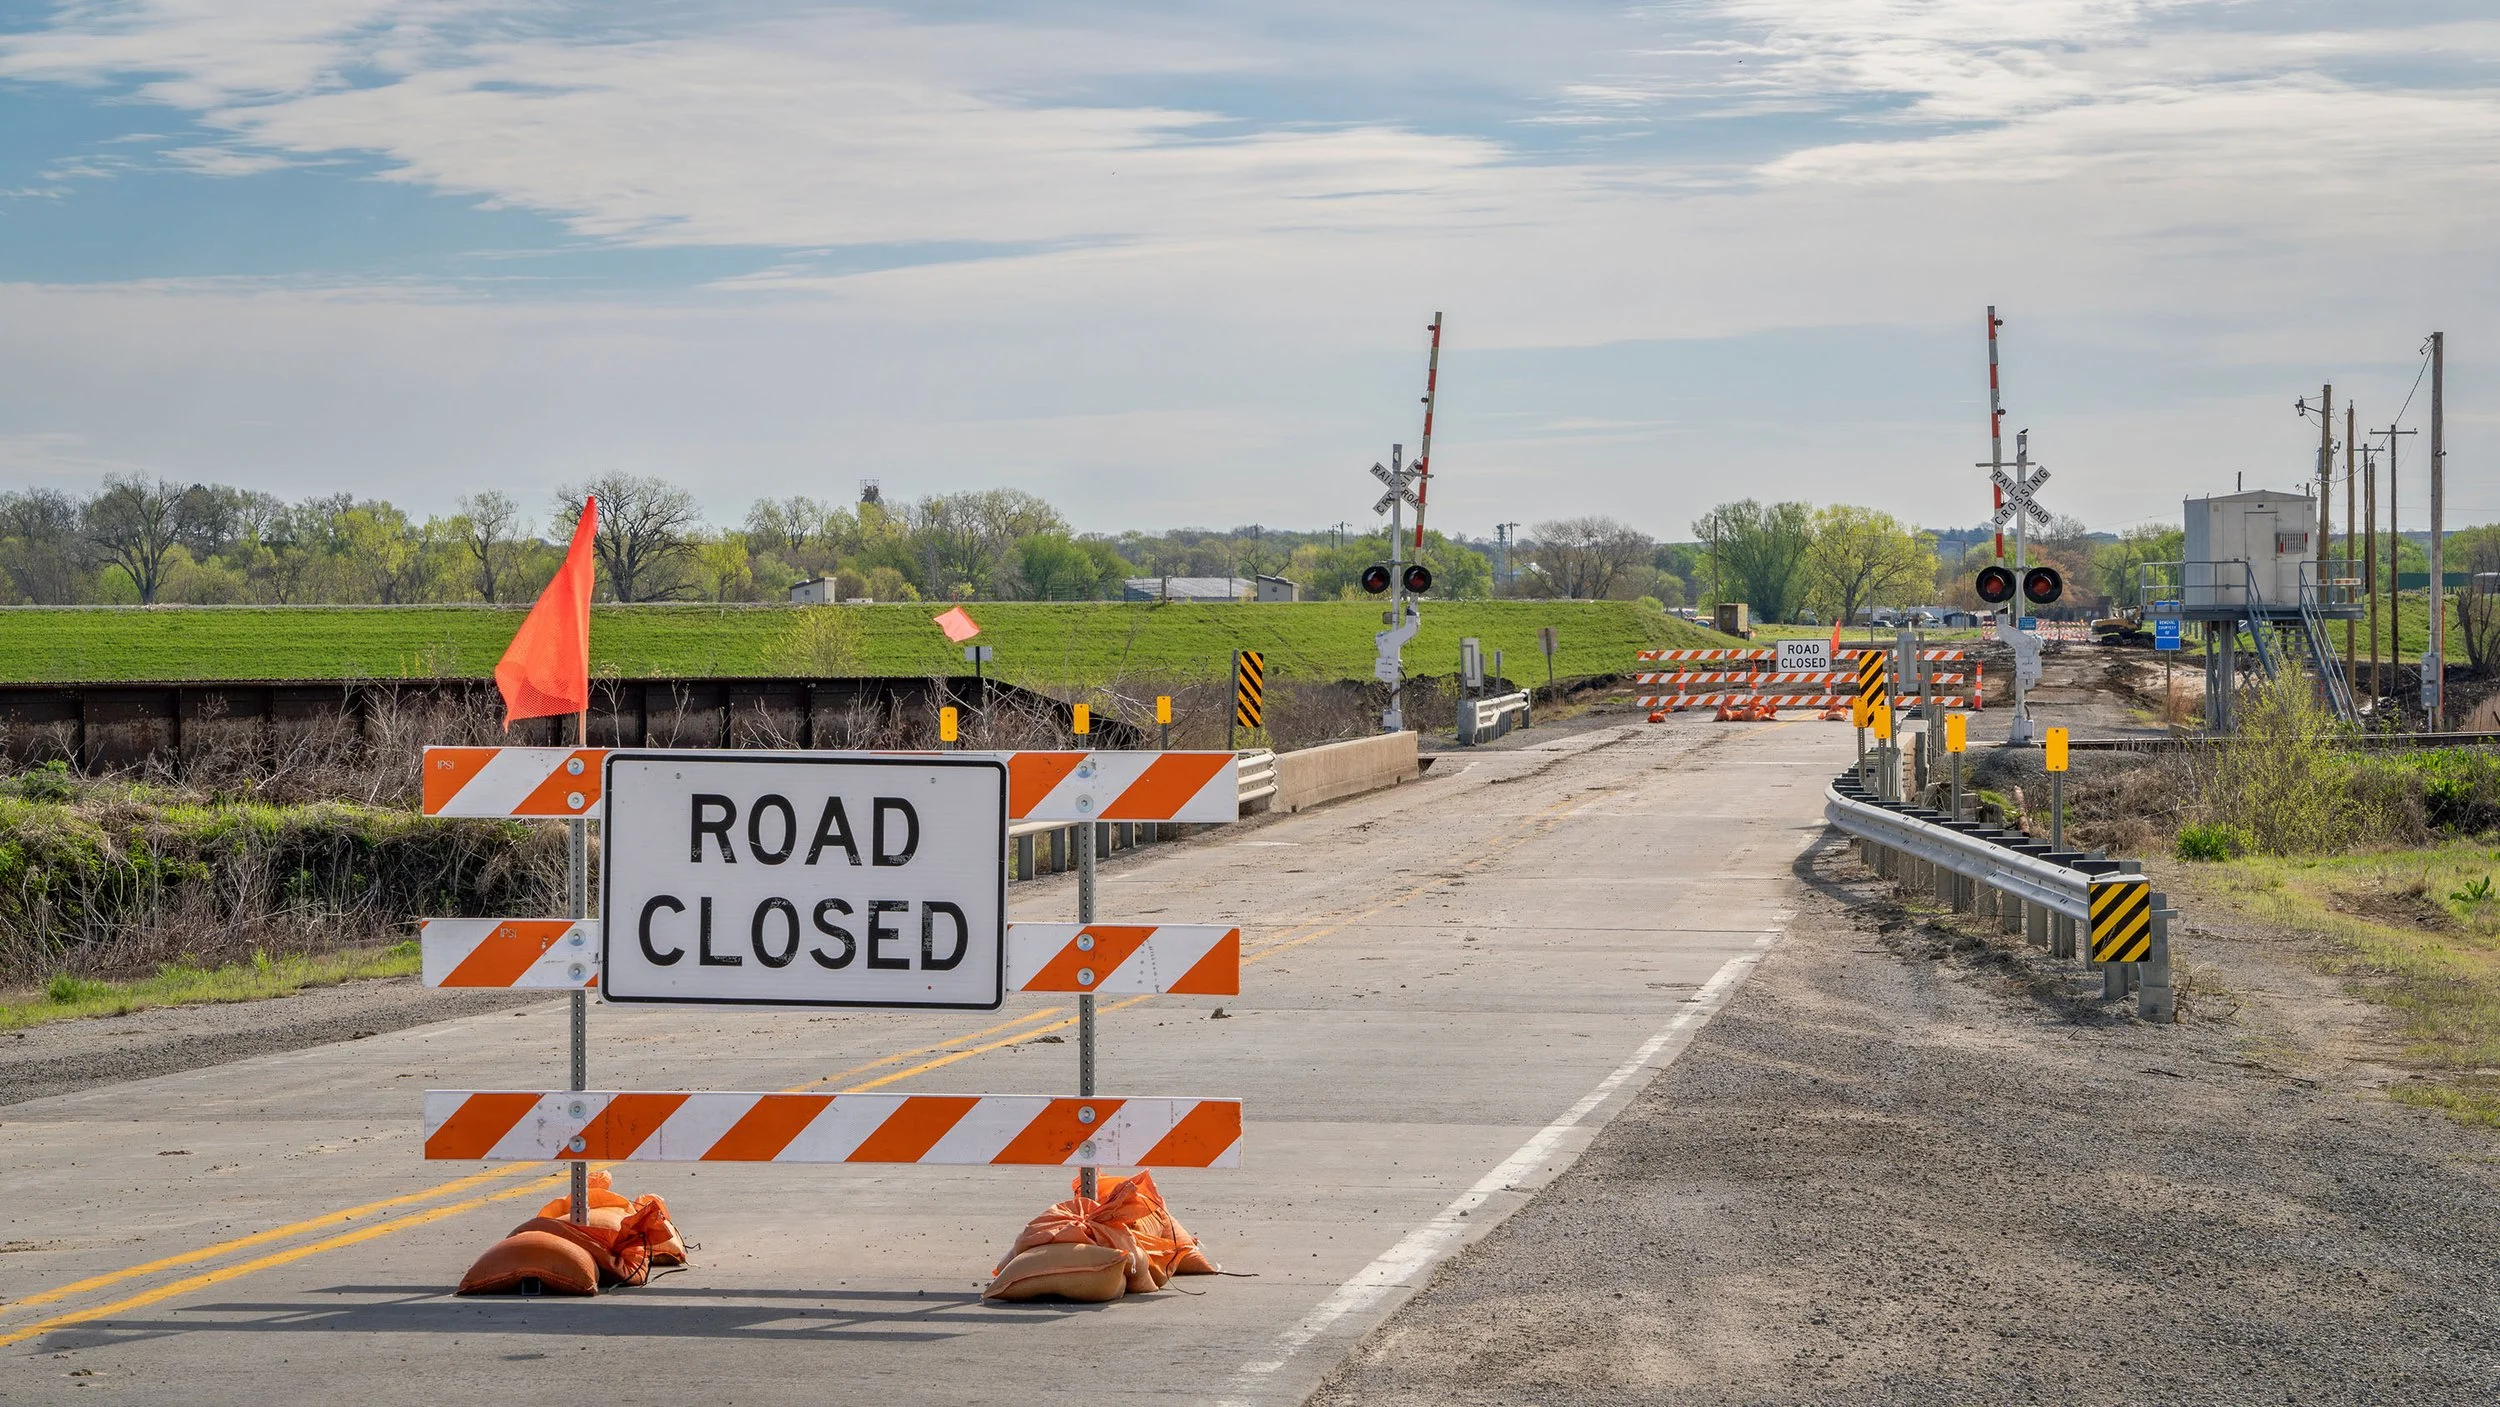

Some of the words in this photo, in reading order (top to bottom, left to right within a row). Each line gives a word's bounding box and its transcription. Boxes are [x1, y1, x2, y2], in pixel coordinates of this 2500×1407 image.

[1401, 488, 1419, 508] ROA
[1994, 469, 2048, 525] CROSSING
[1781, 657, 1827, 669] CLOSED
[1787, 644, 1820, 655] ROAD
[690, 793, 920, 867] ROAD
[638, 894, 969, 971] CLOSED
